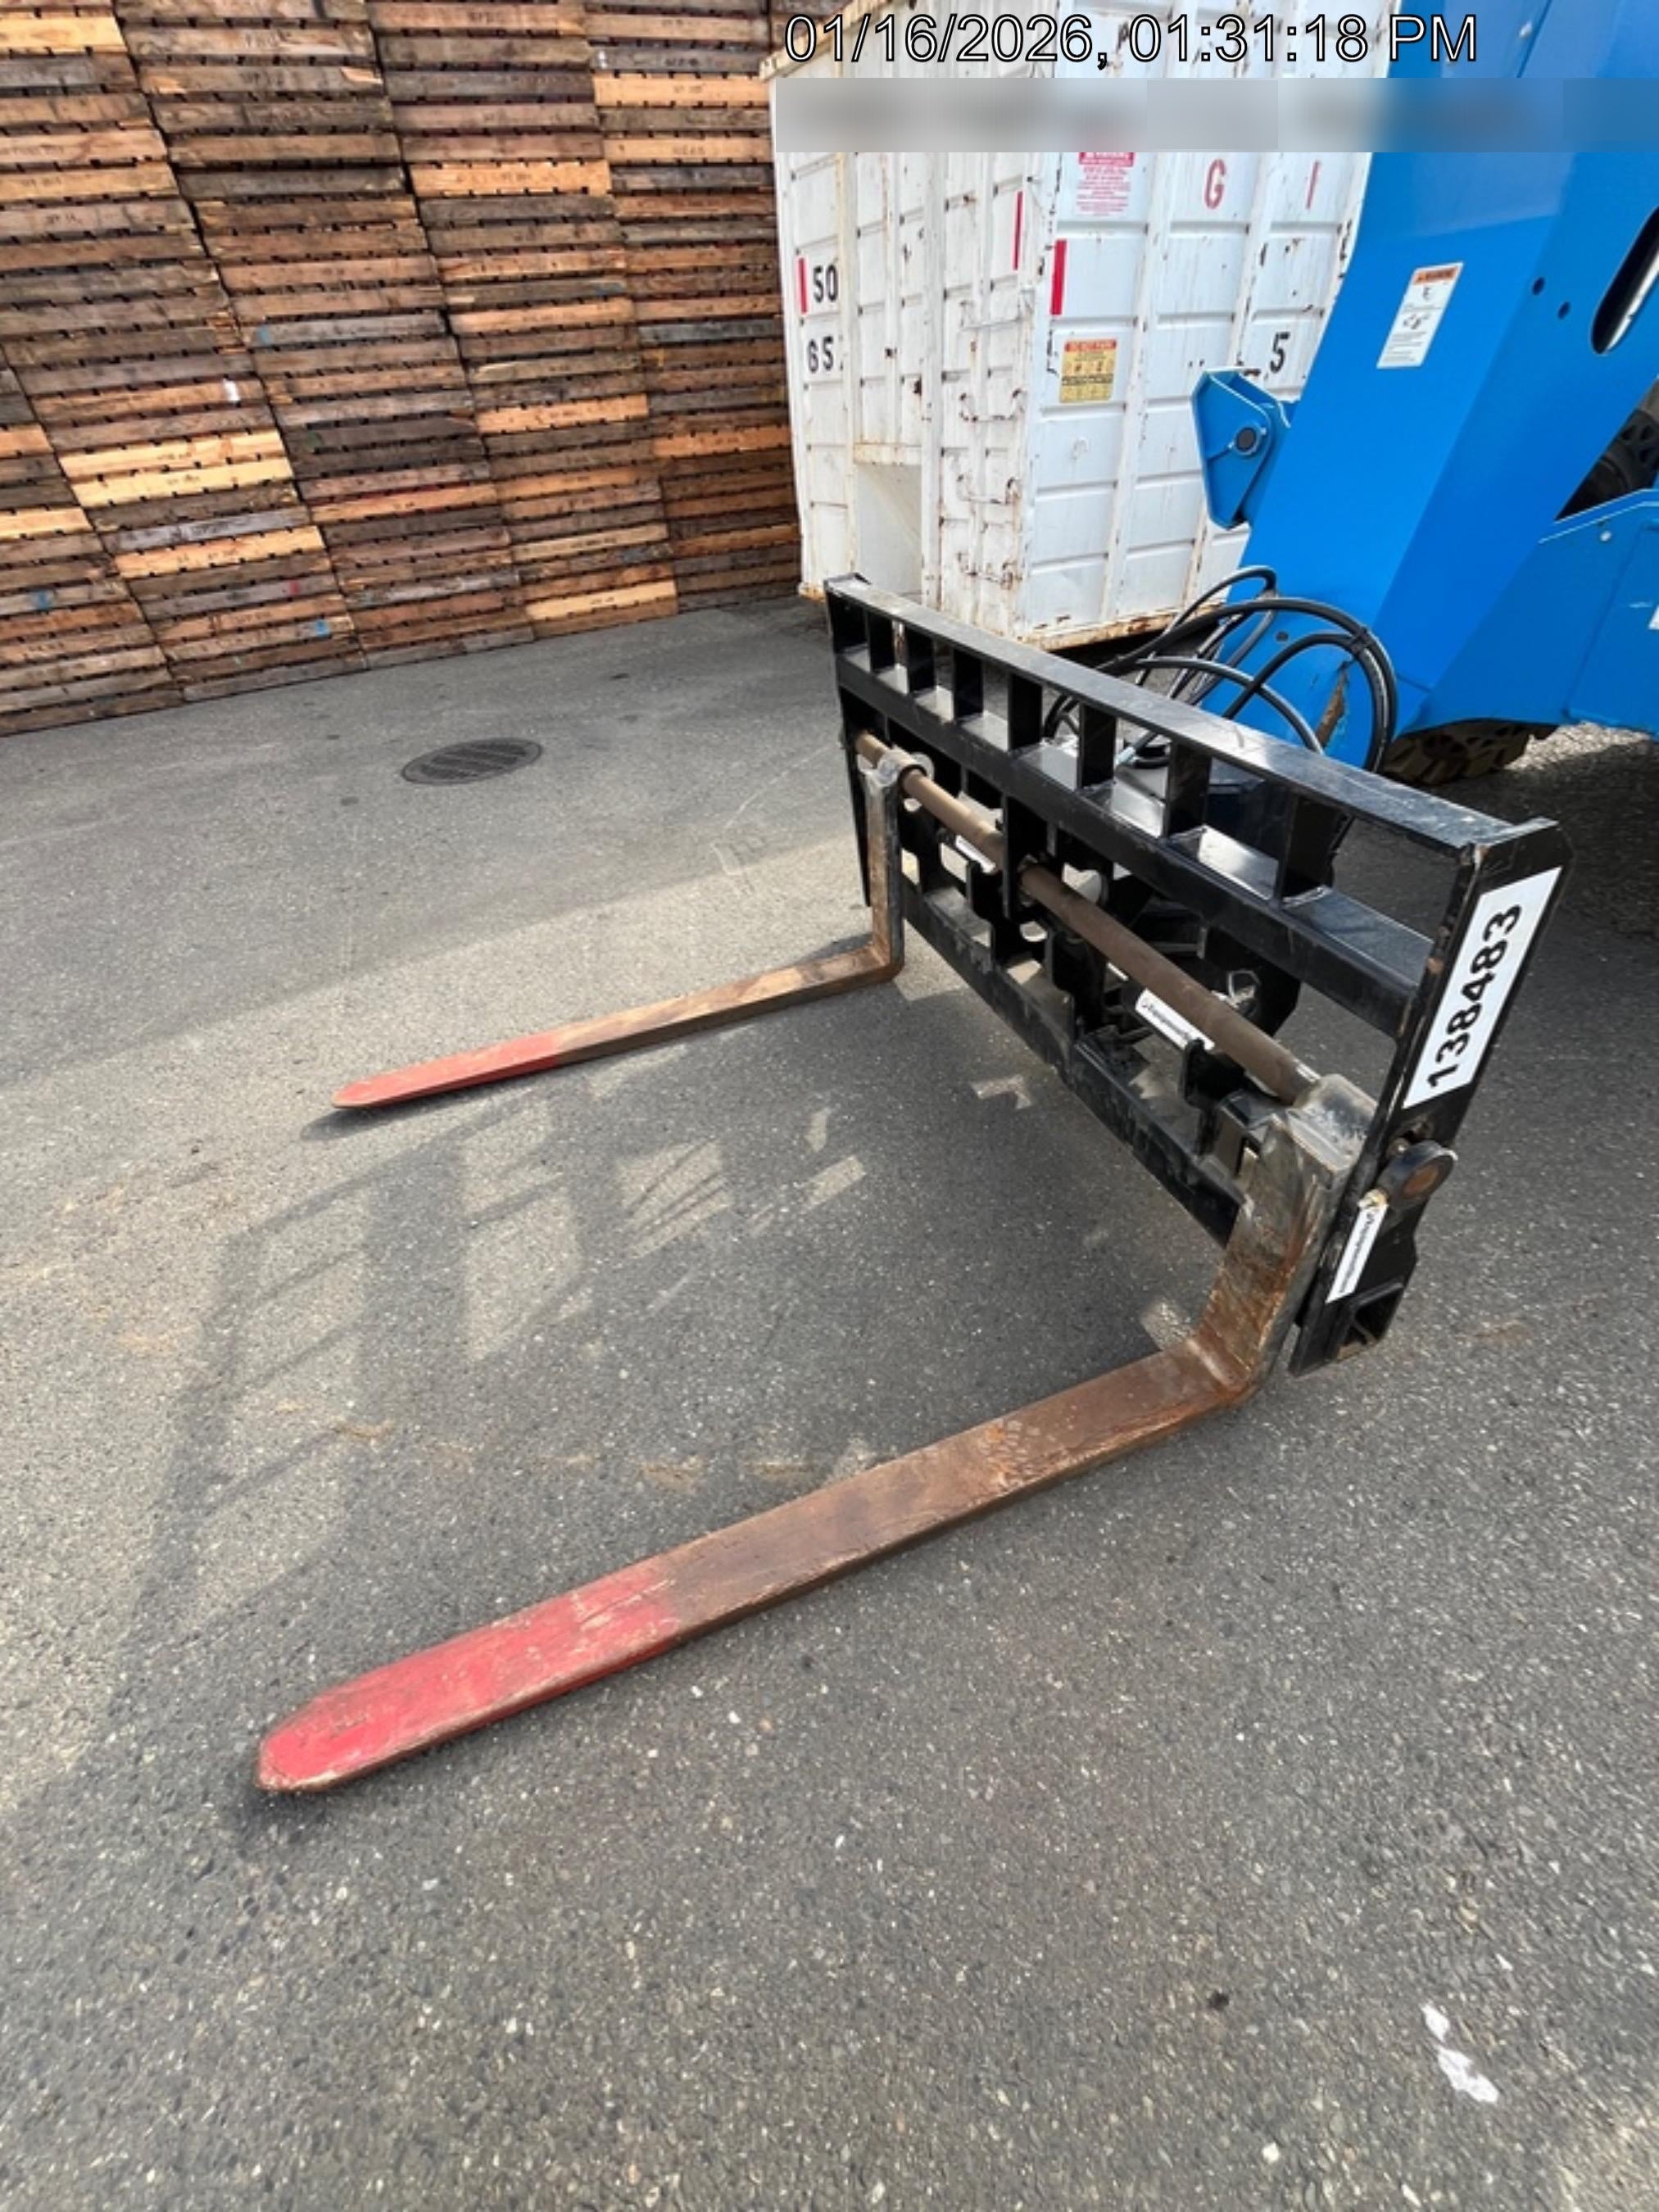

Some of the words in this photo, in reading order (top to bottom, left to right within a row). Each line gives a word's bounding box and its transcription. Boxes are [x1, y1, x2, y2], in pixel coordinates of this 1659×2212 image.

[1204, 158, 1226, 210] G
[813, 263, 838, 303] 50
[808, 335, 834, 374] 65
[1270, 331, 1290, 373] 5
[1426, 904, 1521, 1088] 138483
